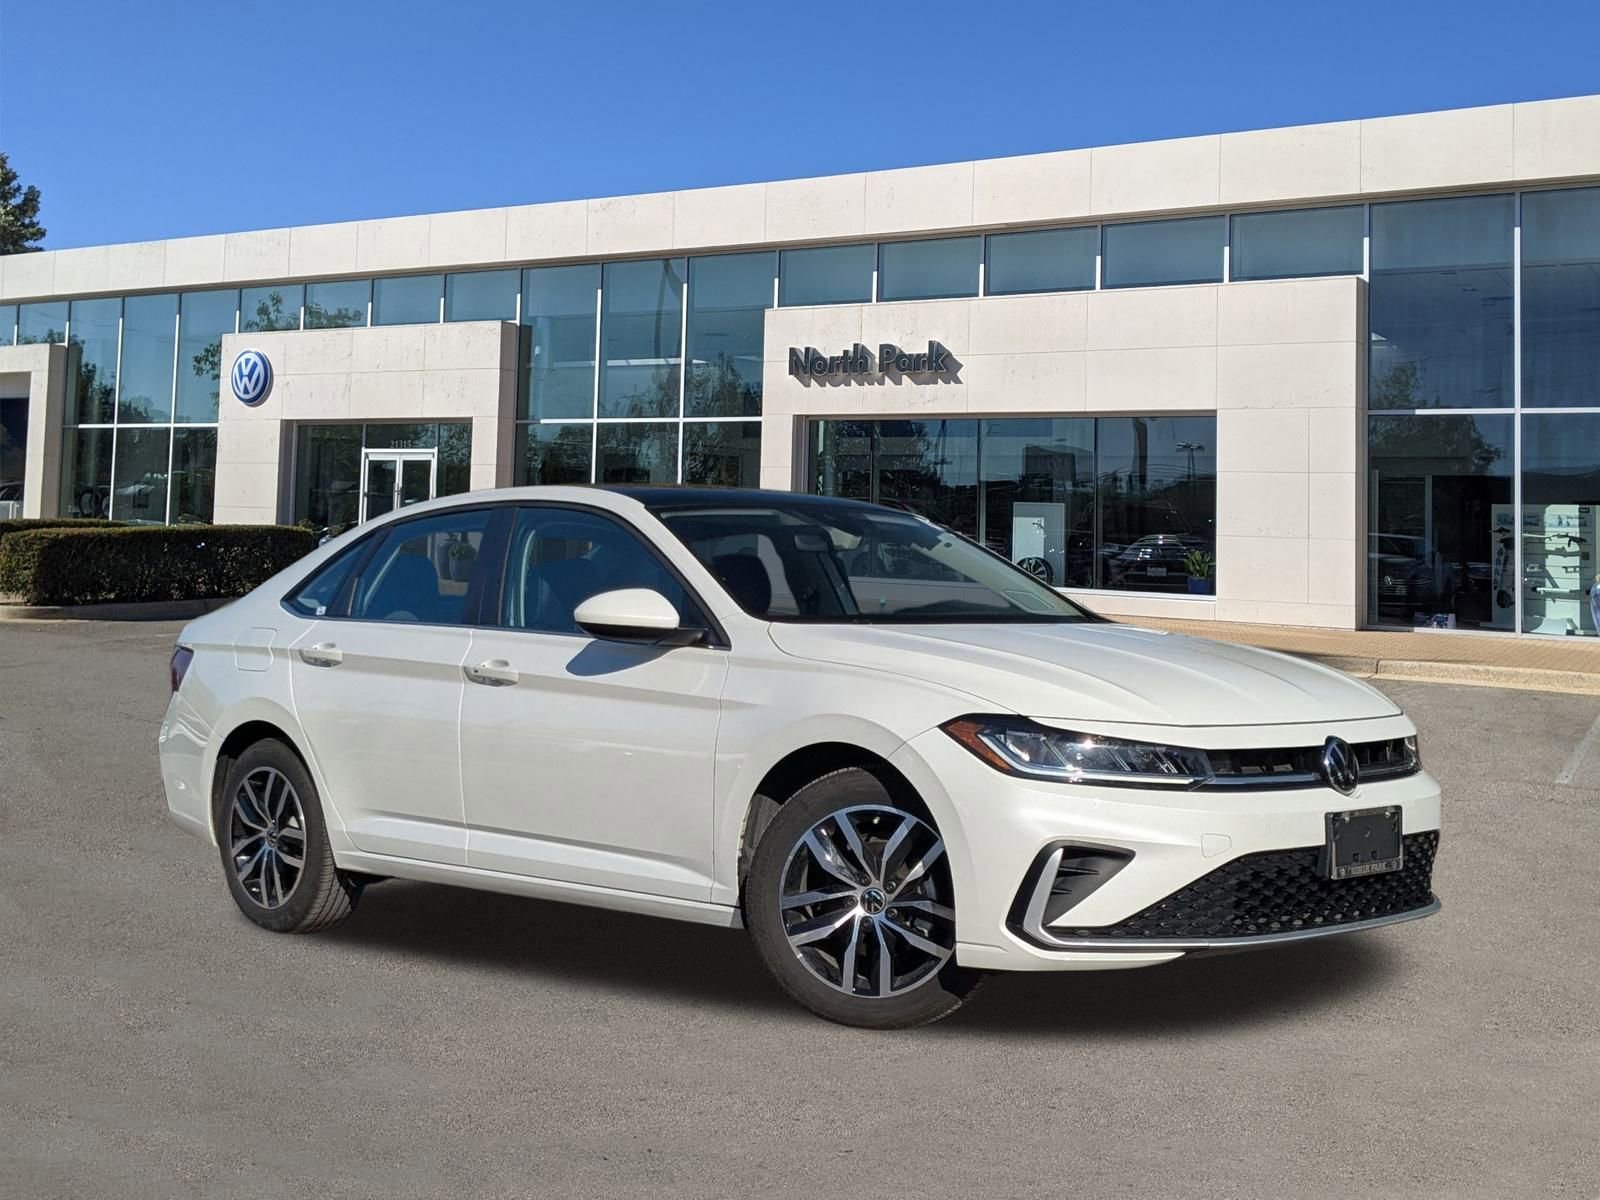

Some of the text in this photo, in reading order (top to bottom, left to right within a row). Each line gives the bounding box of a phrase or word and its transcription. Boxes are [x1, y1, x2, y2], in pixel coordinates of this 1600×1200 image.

[232, 352, 265, 399] VW
[789, 340, 947, 376] North Park
